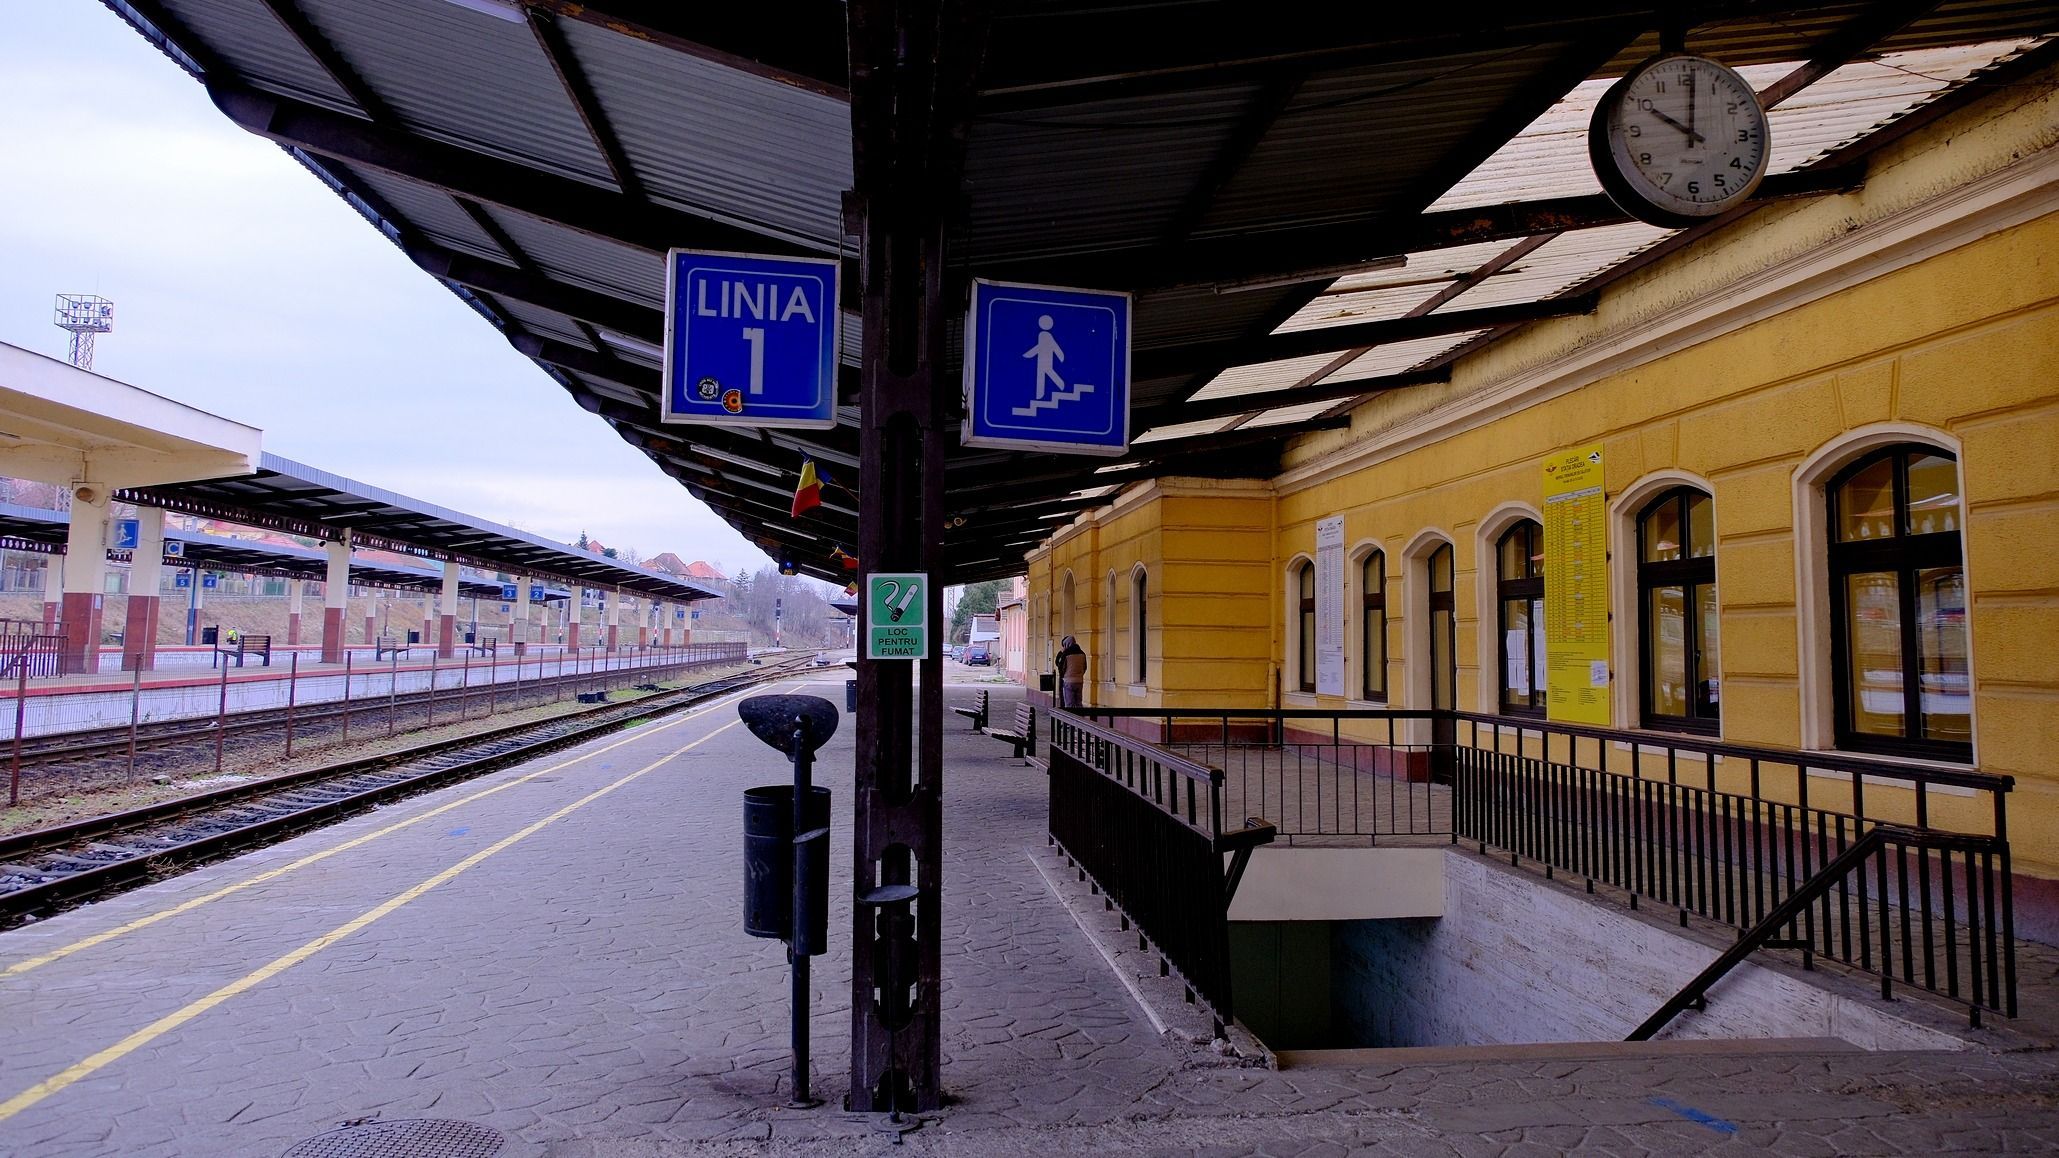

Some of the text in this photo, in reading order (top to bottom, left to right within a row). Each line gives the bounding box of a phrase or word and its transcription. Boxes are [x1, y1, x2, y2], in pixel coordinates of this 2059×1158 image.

[1656, 81, 1665, 93] 11
[1711, 83, 1716, 95] 1
[1638, 99, 1653, 111] 10
[1727, 102, 1738, 115] 2
[1630, 125, 1641, 138] 9
[1738, 130, 1748, 142] 3
[1640, 153, 1651, 165] 8
[1730, 157, 1742, 169] 4
[1662, 173, 1673, 185] 7
[1714, 174, 1725, 186] 5
[1688, 182, 1699, 194] 6
[698, 279, 815, 323] LINIA
[743, 327, 764, 395] 1
[168, 543, 179, 554] C
